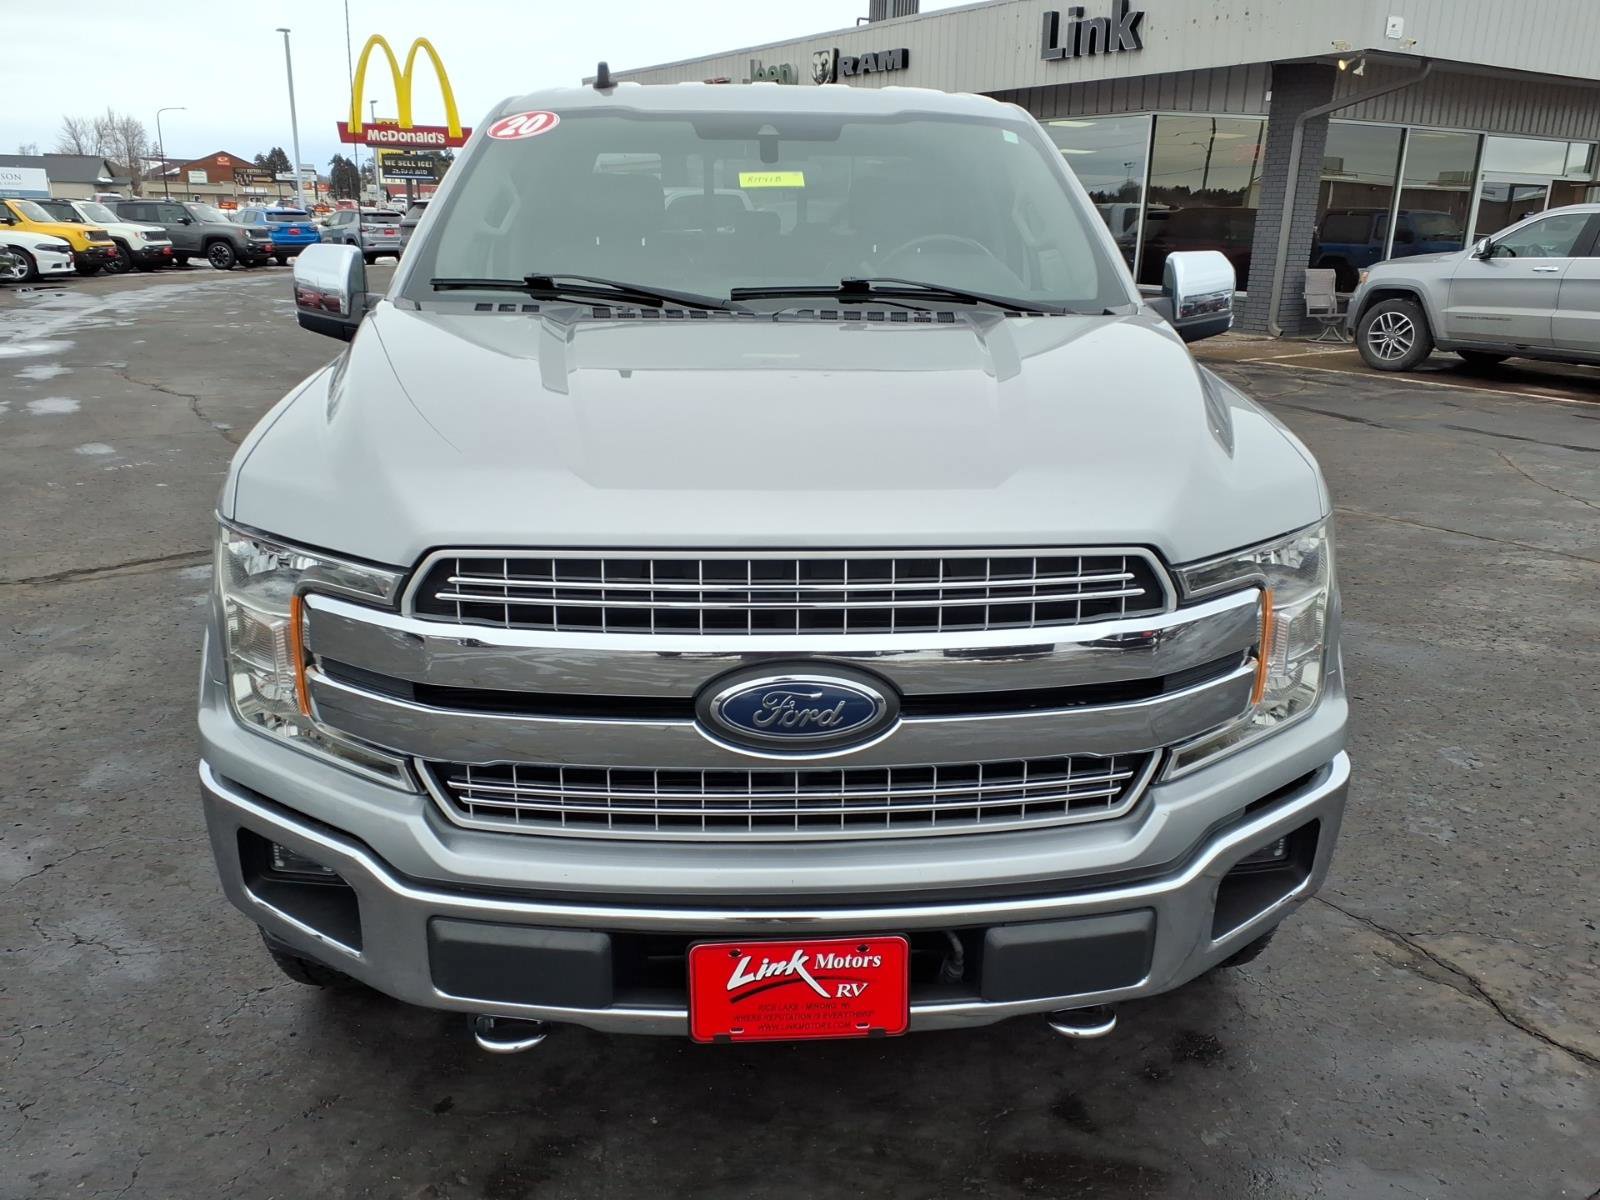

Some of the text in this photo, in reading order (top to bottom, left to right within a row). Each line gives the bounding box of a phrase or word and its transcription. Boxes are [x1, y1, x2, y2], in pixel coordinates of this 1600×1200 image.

[1040, 0, 1145, 61] Link
[837, 48, 909, 77] RAM
[367, 129, 446, 144] McDonald's
[497, 113, 548, 136] 20
[384, 159, 396, 167] WE
[398, 160, 416, 168] SELL
[752, 690, 847, 728] Ford
[726, 949, 882, 999] Link Motors
[836, 982, 869, 999] RV
